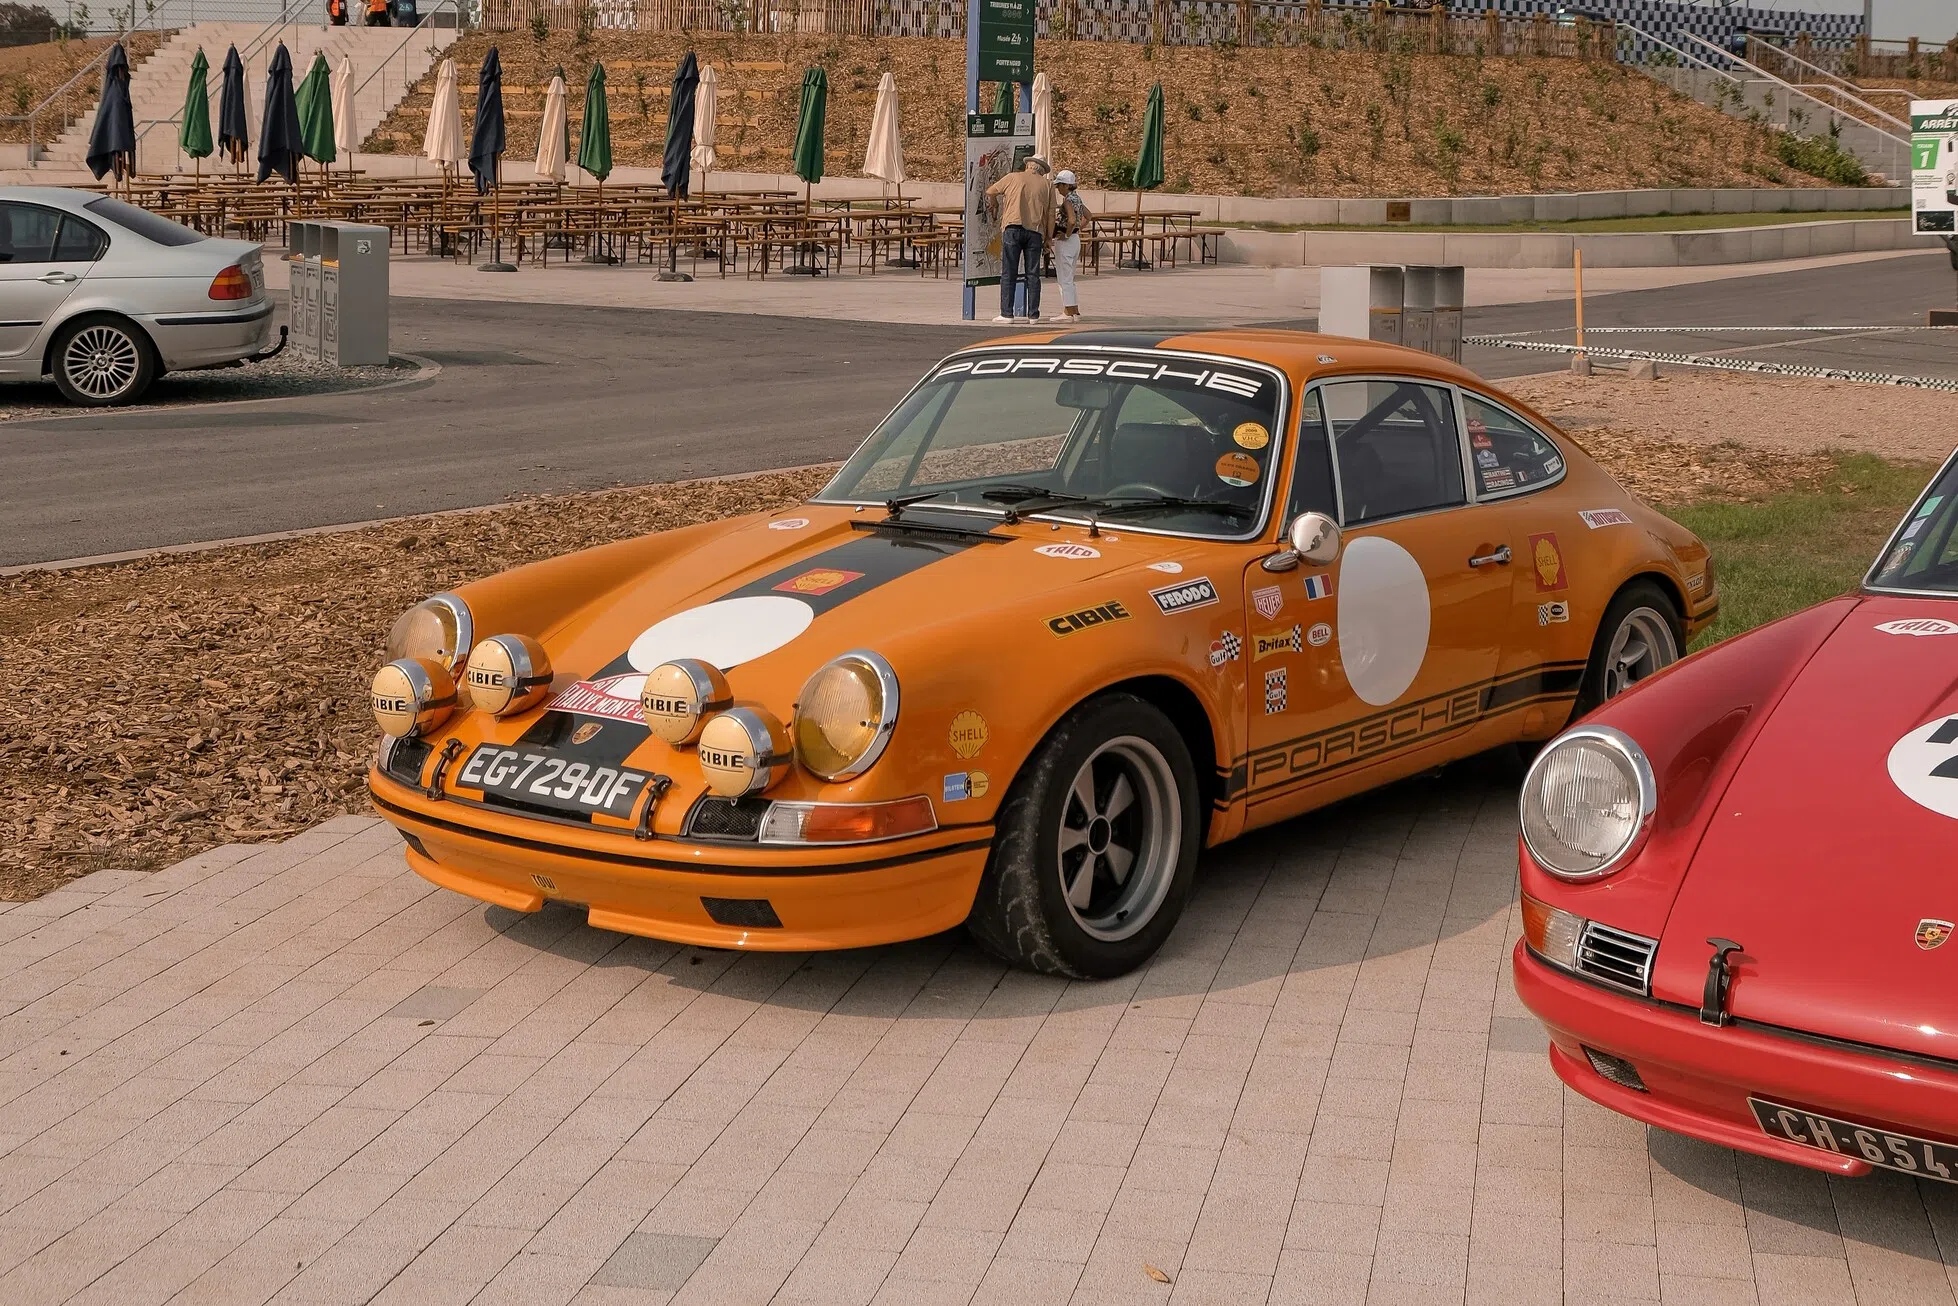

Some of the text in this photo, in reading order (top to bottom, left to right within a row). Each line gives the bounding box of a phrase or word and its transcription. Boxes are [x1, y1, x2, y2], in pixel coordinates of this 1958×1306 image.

[994, 119, 1009, 129] Plan
[1920, 151, 1929, 168] 1
[931, 358, 1262, 398] PORSCHE
[1046, 545, 1093, 557] TRICO
[1537, 555, 1558, 567] SHELL
[1158, 584, 1211, 608] FERODO
[1257, 593, 1280, 615] HEUER
[1312, 628, 1329, 640] BELL
[1889, 620, 1951, 633] TRICO
[1258, 637, 1291, 653] Britax
[1211, 651, 1226, 664] Gulf
[1266, 669, 1285, 679] team
[550, 684, 602, 712] RALLYE
[1269, 689, 1284, 699] Gulf
[953, 728, 984, 742] SHELL
[1252, 689, 1480, 785] PORSCHE
[461, 747, 645, 809] EG-729-DF
[531, 873, 556, 890] TOW
